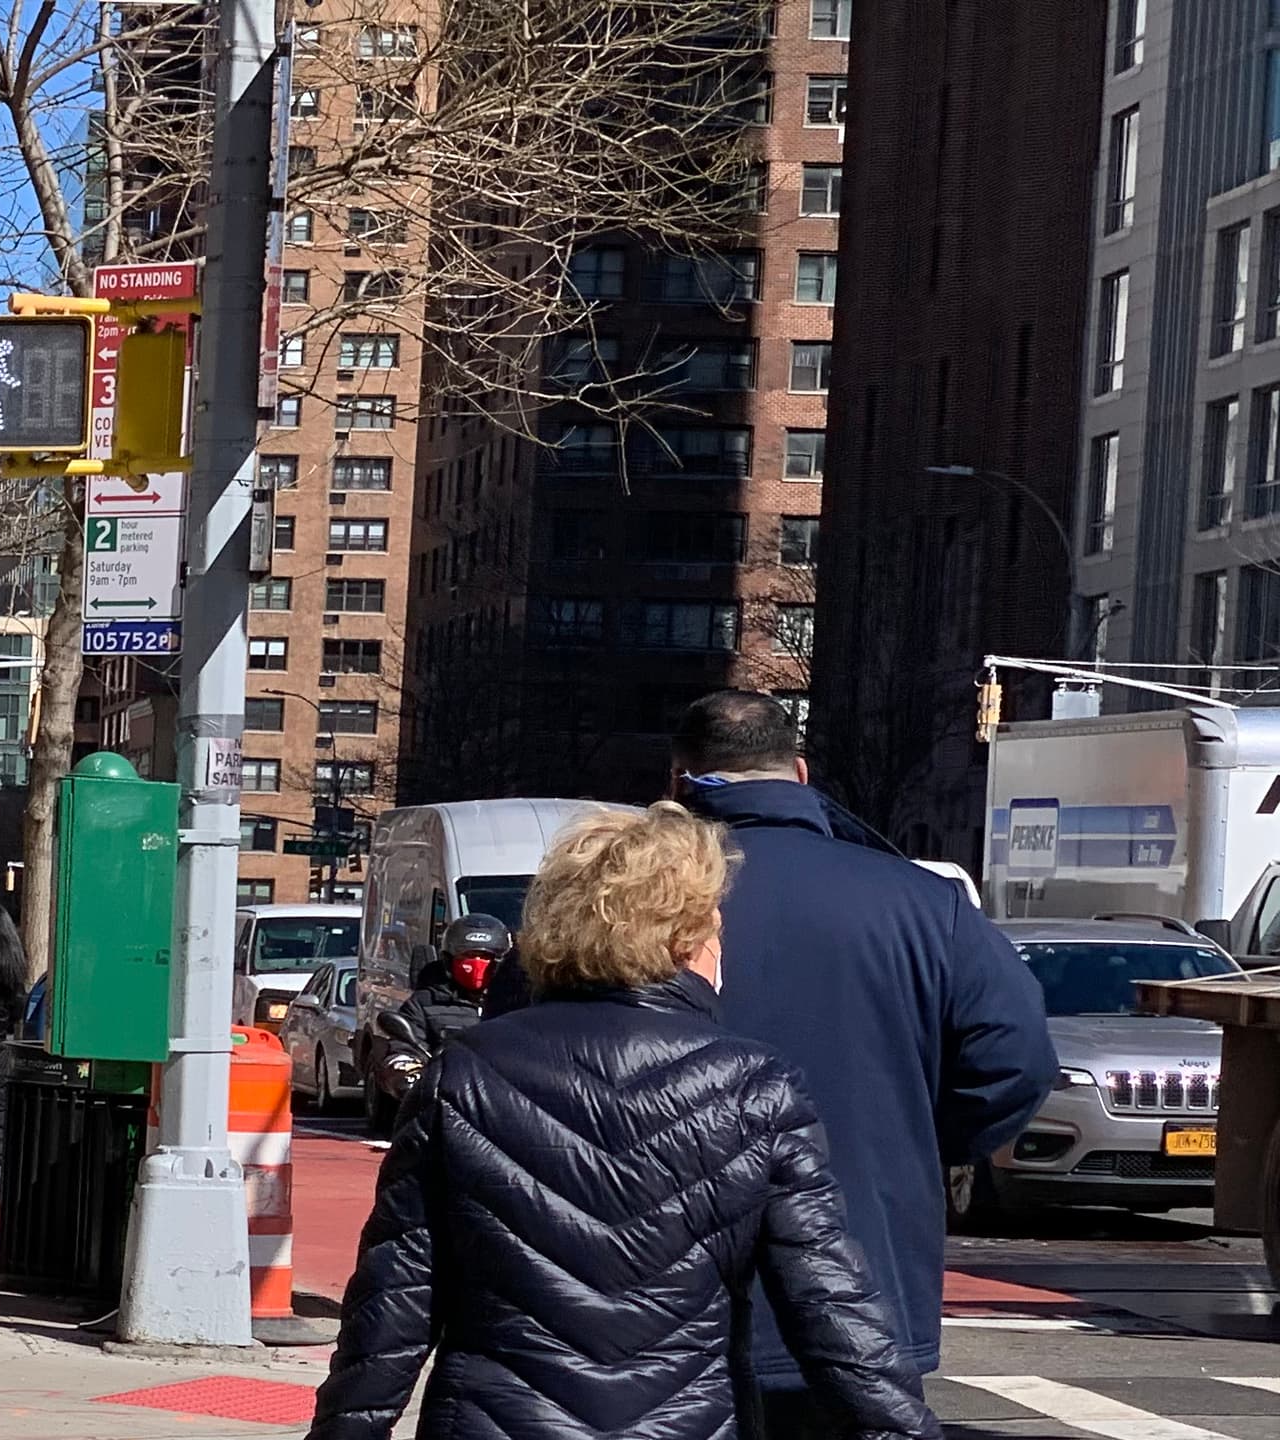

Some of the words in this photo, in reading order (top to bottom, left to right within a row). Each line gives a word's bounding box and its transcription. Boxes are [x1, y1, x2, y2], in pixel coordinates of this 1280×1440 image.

[100, 274, 117, 289] NO
[120, 271, 182, 288] STANDING
[100, 375, 116, 405] 3
[95, 520, 111, 549] 2
[121, 521, 138, 530] hour
[120, 531, 153, 541] metered
[120, 543, 149, 554] parking
[90, 561, 132, 574] Saturday
[90, 574, 109, 586] 9am
[118, 574, 137, 588] 7pm
[85, 632, 157, 650] 105752
[216, 752, 241, 767] PAR
[212, 772, 241, 786] SATU
[1011, 824, 1056, 851] PENSKE
